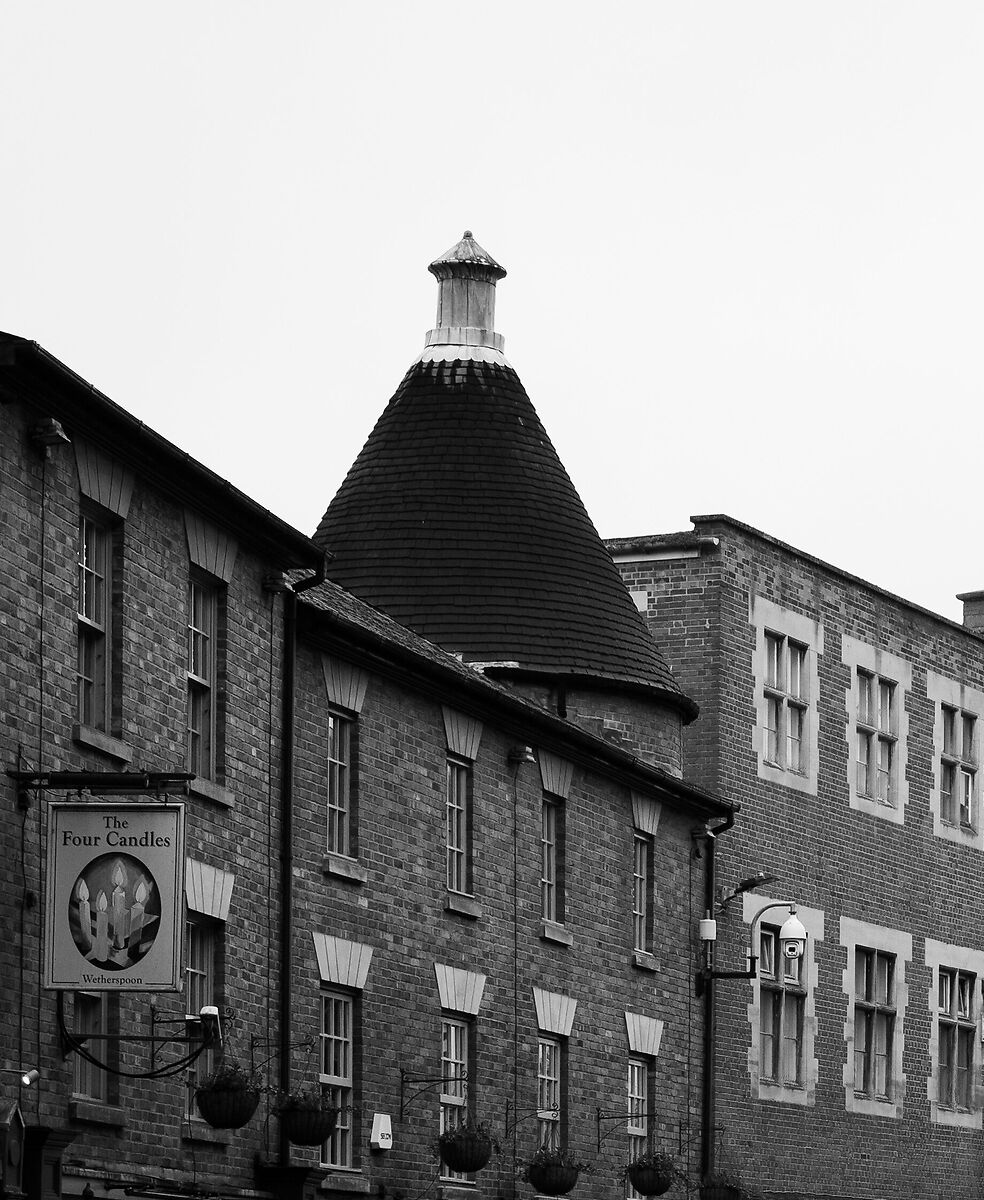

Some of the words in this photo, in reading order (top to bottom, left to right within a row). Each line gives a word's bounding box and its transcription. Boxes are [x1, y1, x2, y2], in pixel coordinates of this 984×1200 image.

[103, 816, 128, 829] The
[62, 831, 101, 847] Four
[106, 831, 171, 847] Candles
[82, 974, 143, 986] Wetherspoon
